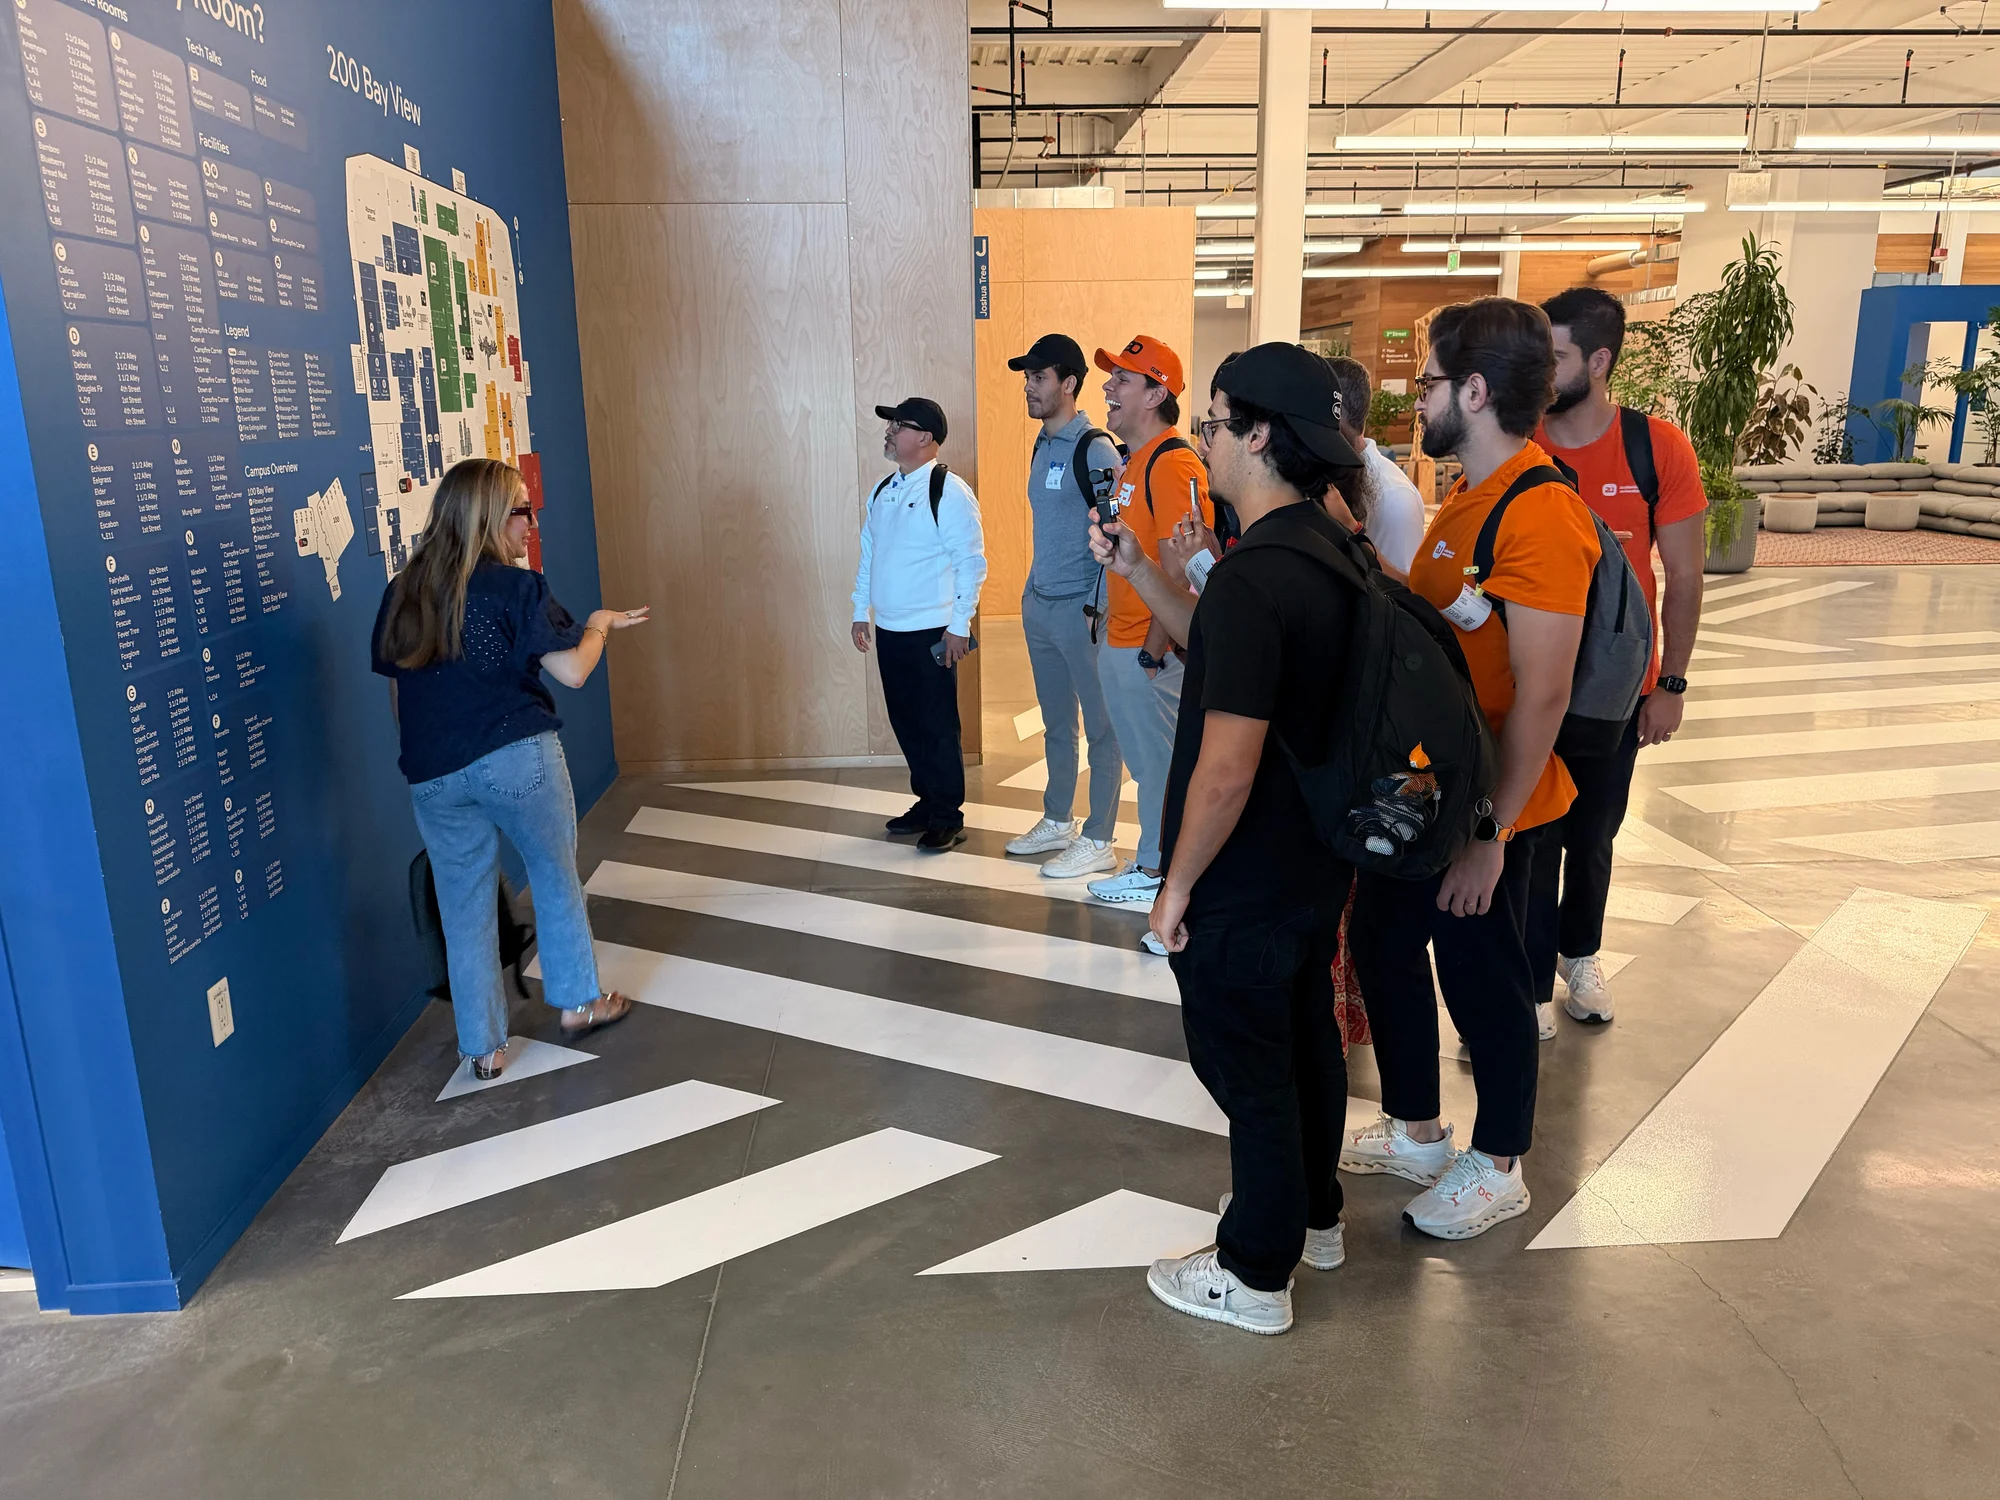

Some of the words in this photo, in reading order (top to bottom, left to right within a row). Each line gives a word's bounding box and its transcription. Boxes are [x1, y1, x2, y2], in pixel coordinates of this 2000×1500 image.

[97, 0, 128, 22] Rooms
[192, 0, 265, 44] oom?
[186, 37, 204, 57] Tech
[204, 45, 222, 66] Talks
[251, 69, 267, 88] Food
[327, 45, 359, 93] 200
[362, 65, 388, 117] Bay
[390, 81, 421, 127] View
[198, 133, 230, 155] Facilities
[224, 323, 249, 339] Legend
[245, 465, 270, 479] Campus
[270, 461, 298, 475] Overview
[248, 488, 256, 496] 100
[257, 487, 265, 496] Bay
[265, 485, 274, 494] View
[262, 595, 270, 605] 300
[270, 594, 278, 603] Bay
[278, 591, 287, 600] View
